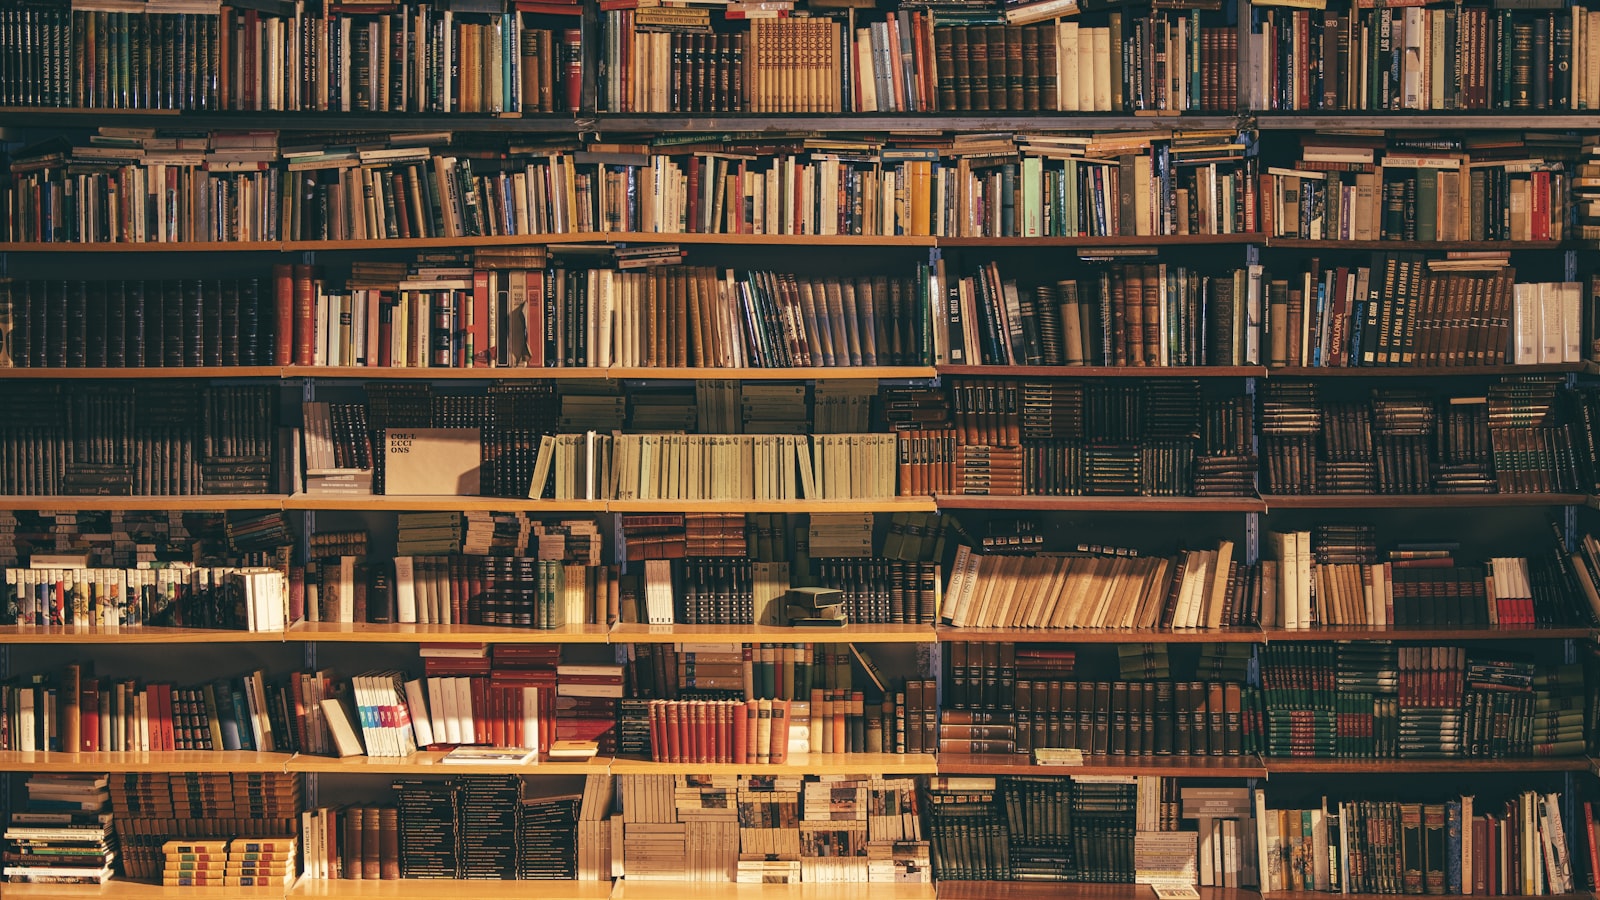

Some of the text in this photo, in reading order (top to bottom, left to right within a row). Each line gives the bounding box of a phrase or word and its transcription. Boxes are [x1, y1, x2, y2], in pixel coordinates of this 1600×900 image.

[824, 23, 832, 70] BRICOLAJE
[1380, 10, 1390, 52] LAS CIENCIAS
[950, 288, 957, 296] XX
[1370, 291, 1378, 299] XX
[1411, 262, 1421, 296] OCCIDENTAL
[1369, 302, 1378, 316] SIGLO
[1380, 259, 1396, 346] CIVILIZACIONES EXTINGUIDAS
[1393, 319, 1402, 336] ÉPOCA
[1398, 262, 1408, 294] EXPANSIÓN
[1332, 313, 1342, 355] CATALONIA
[1406, 299, 1417, 336] CIVILIZACIÓN
[953, 551, 967, 585] PARNASO
[963, 560, 977, 593] PARNASO
